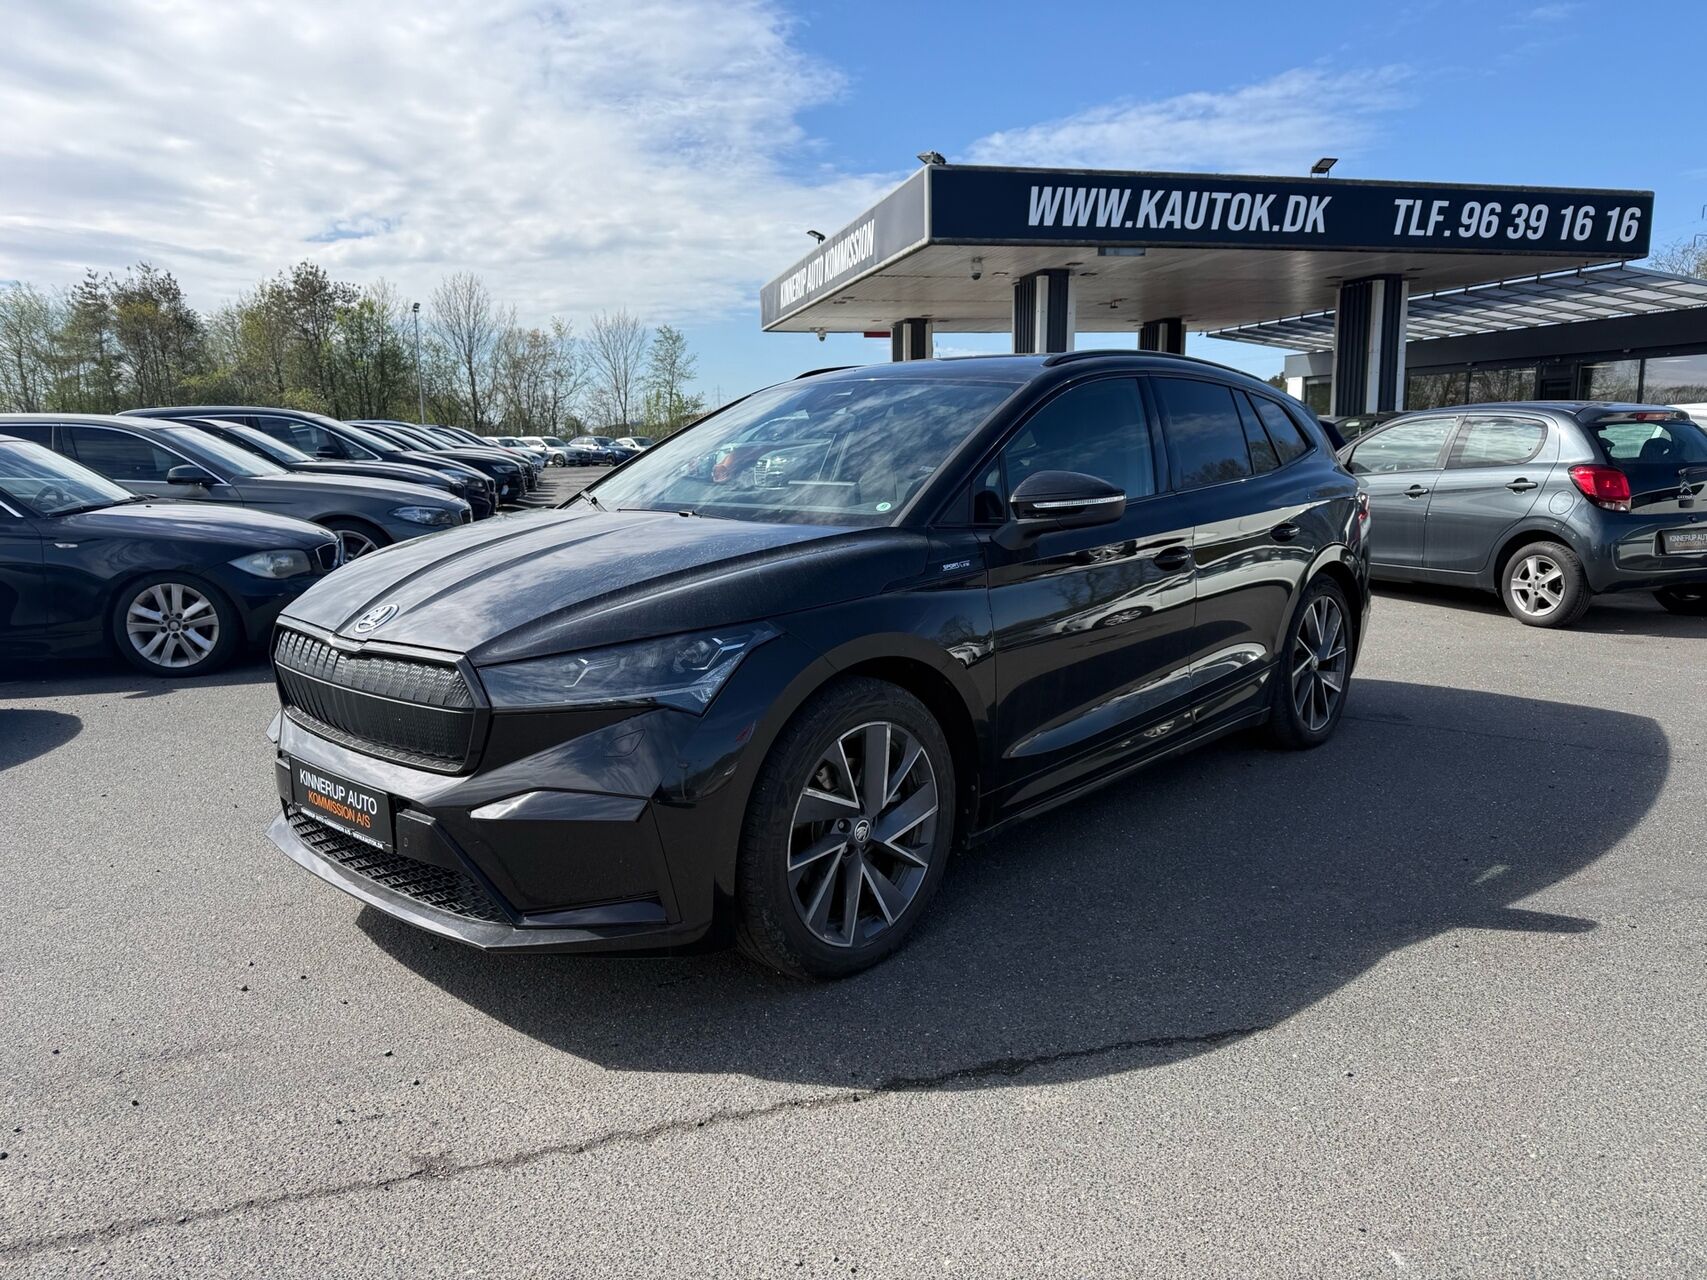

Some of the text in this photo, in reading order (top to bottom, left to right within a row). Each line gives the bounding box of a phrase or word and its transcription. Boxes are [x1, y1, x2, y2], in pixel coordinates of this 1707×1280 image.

[1028, 186, 1332, 233] WWW.KAUTOK.DK
[1393, 199, 1641, 242] TLF. 96 39 16 16
[780, 219, 875, 310] KINNERUP AUTO KOMMISSION
[299, 768, 378, 815] KINNERUP AUTO
[308, 789, 355, 822] KOMMISSION
[356, 812, 371, 828] A/S
